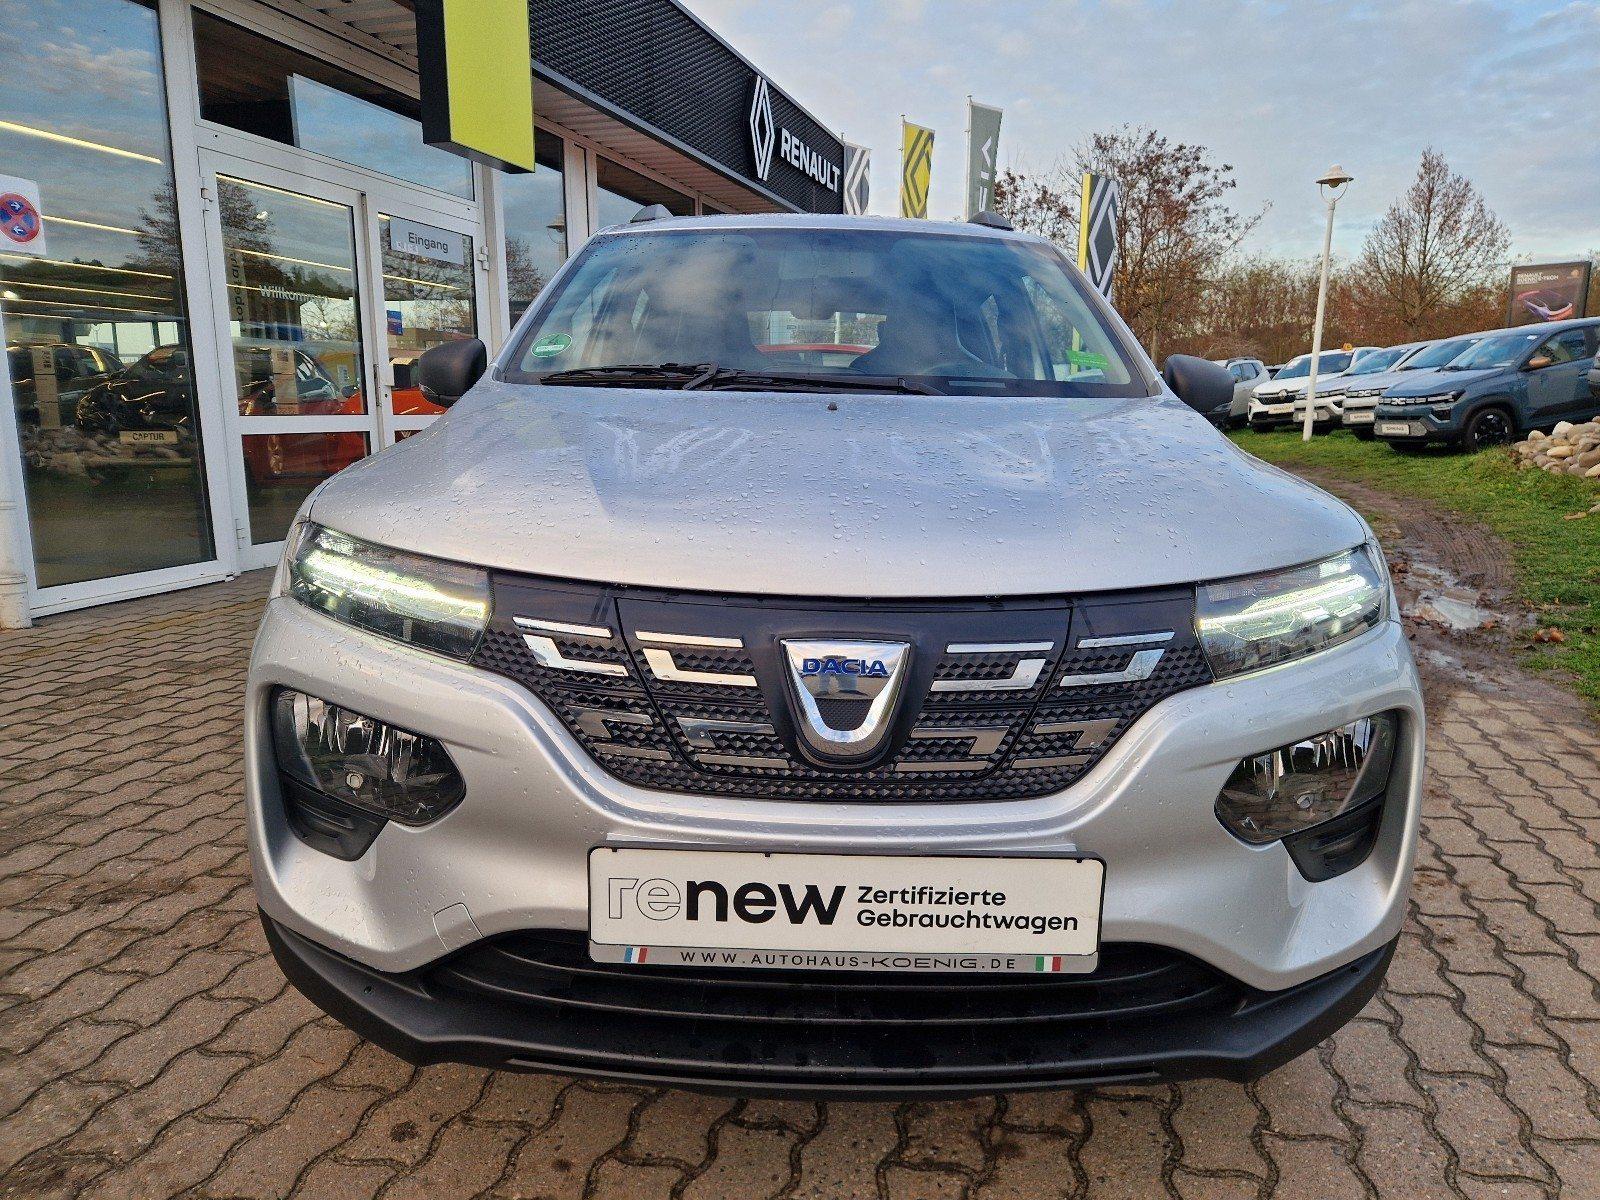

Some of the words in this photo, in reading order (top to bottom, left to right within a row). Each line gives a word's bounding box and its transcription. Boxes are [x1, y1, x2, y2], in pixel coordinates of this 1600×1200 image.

[781, 127, 840, 193] RENAULT
[408, 231, 449, 253] Eingang
[259, 284, 328, 306] Willkom
[133, 432, 165, 441] CAPTUR
[802, 658, 888, 675] DACIA
[608, 878, 847, 925] renew
[857, 886, 1006, 906] Zertifizierte
[856, 909, 1078, 934] Gebrauchtwagen
[680, 951, 1016, 970] WWW.AUTOHAUS-KOENIG.DE
